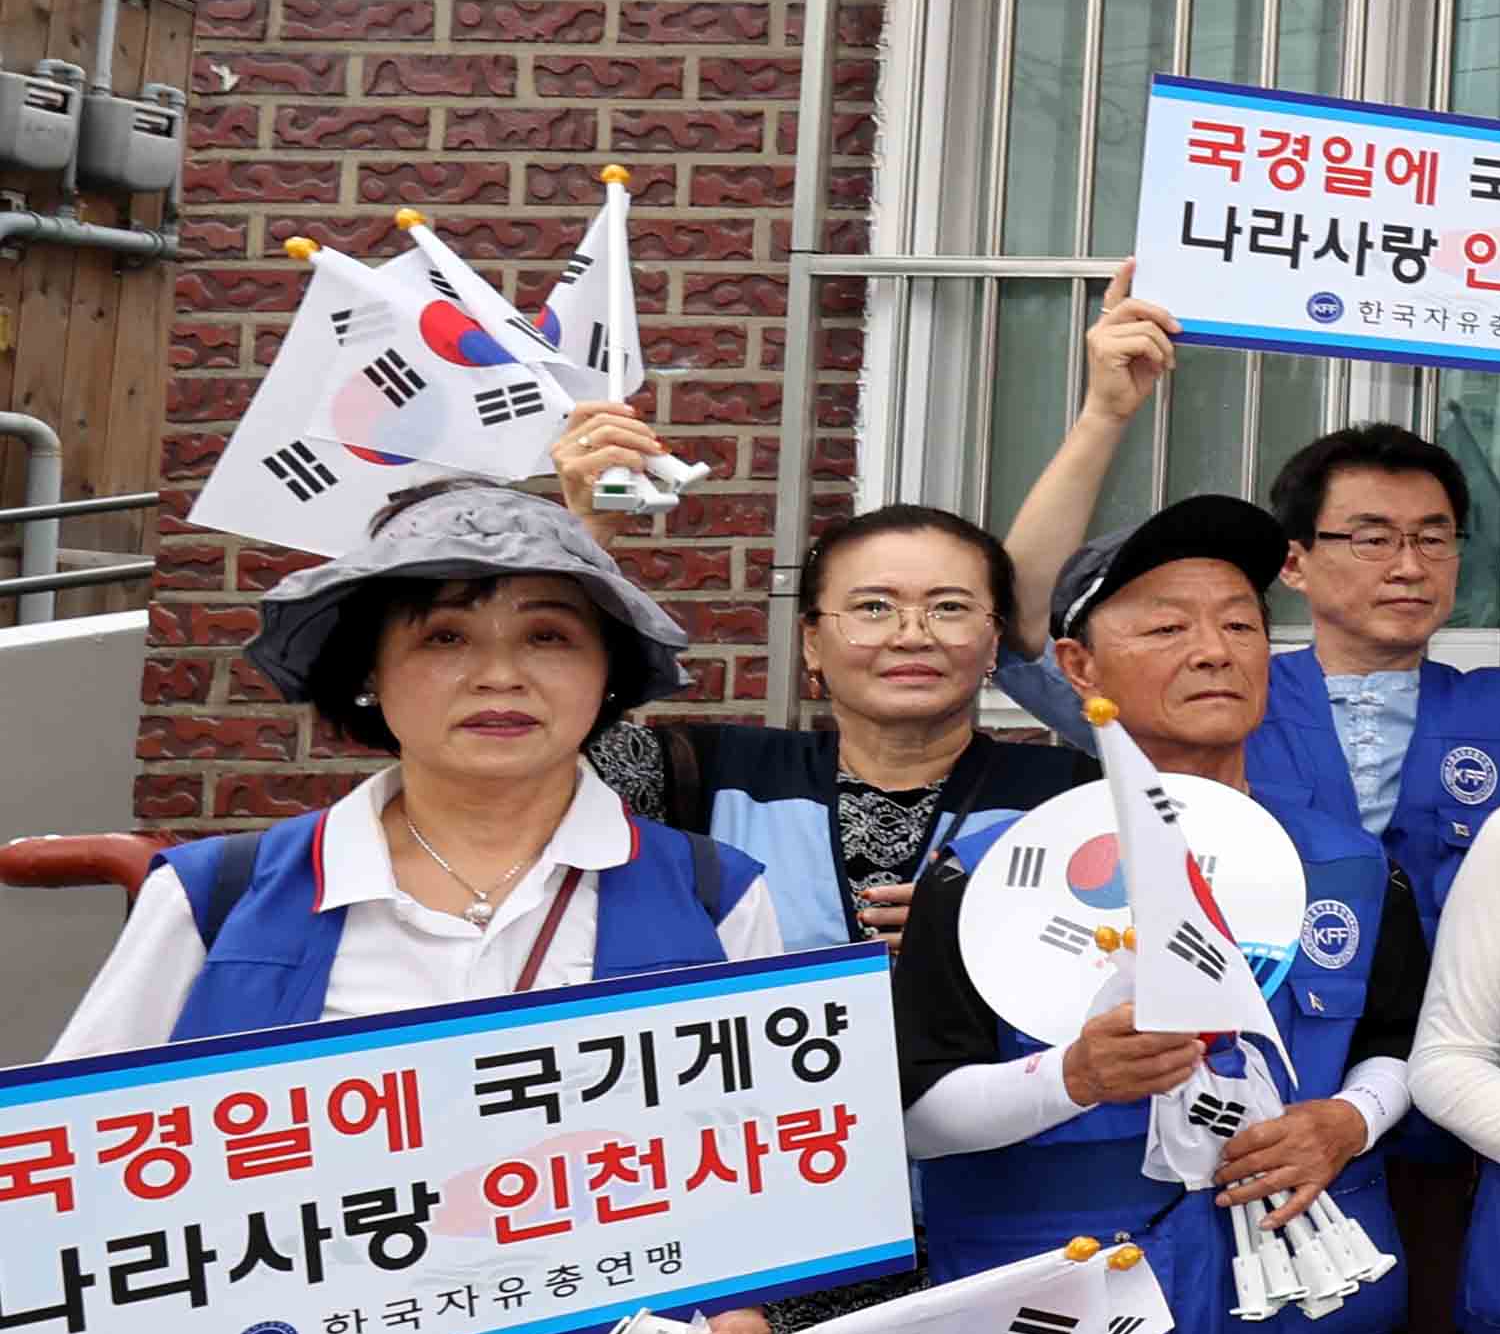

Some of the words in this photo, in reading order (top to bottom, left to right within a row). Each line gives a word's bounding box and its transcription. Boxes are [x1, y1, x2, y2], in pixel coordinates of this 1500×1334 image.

[1186, 119, 1440, 206] 국경일에
[1180, 200, 1438, 284] 나라사랑
[0, 1068, 423, 1213] 국경일에
[473, 1001, 849, 1124] 국기게양
[0, 1179, 442, 1334] 나라사랑
[482, 1104, 858, 1244] 인천사랑
